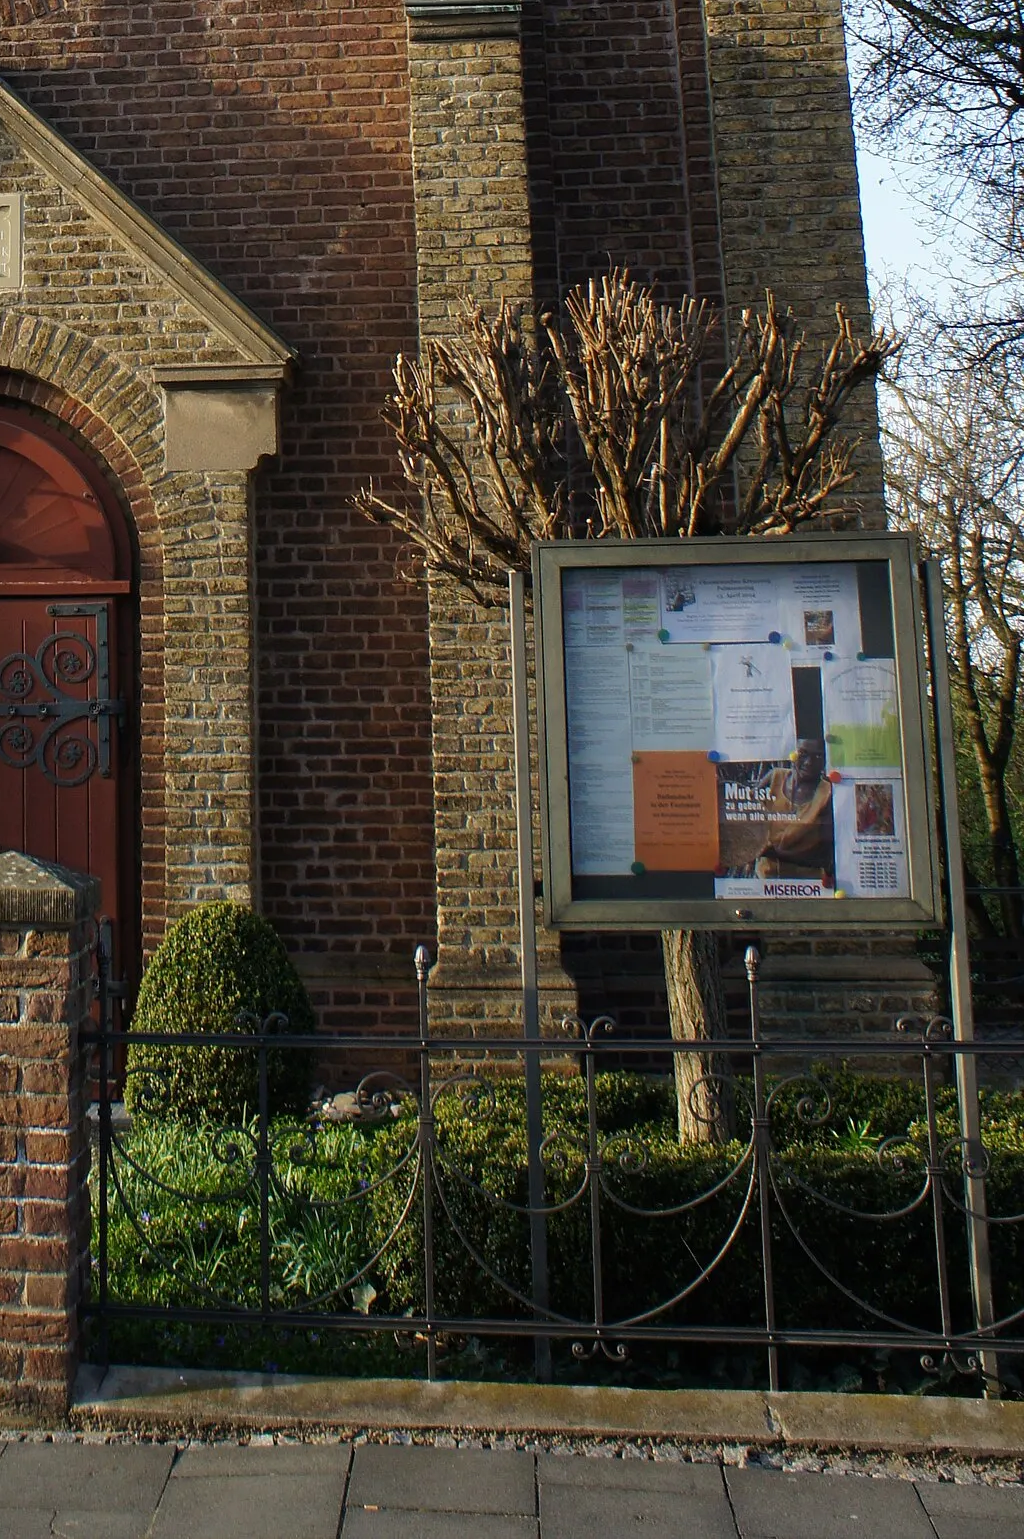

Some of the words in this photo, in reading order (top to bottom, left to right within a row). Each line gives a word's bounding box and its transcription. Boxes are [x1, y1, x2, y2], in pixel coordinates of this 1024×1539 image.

[724, 783, 752, 800] Mut
[725, 802, 735, 810] zu
[725, 813, 747, 821] wenn
[750, 812, 765, 821] alle
[764, 884, 821, 897] MISEREOR
